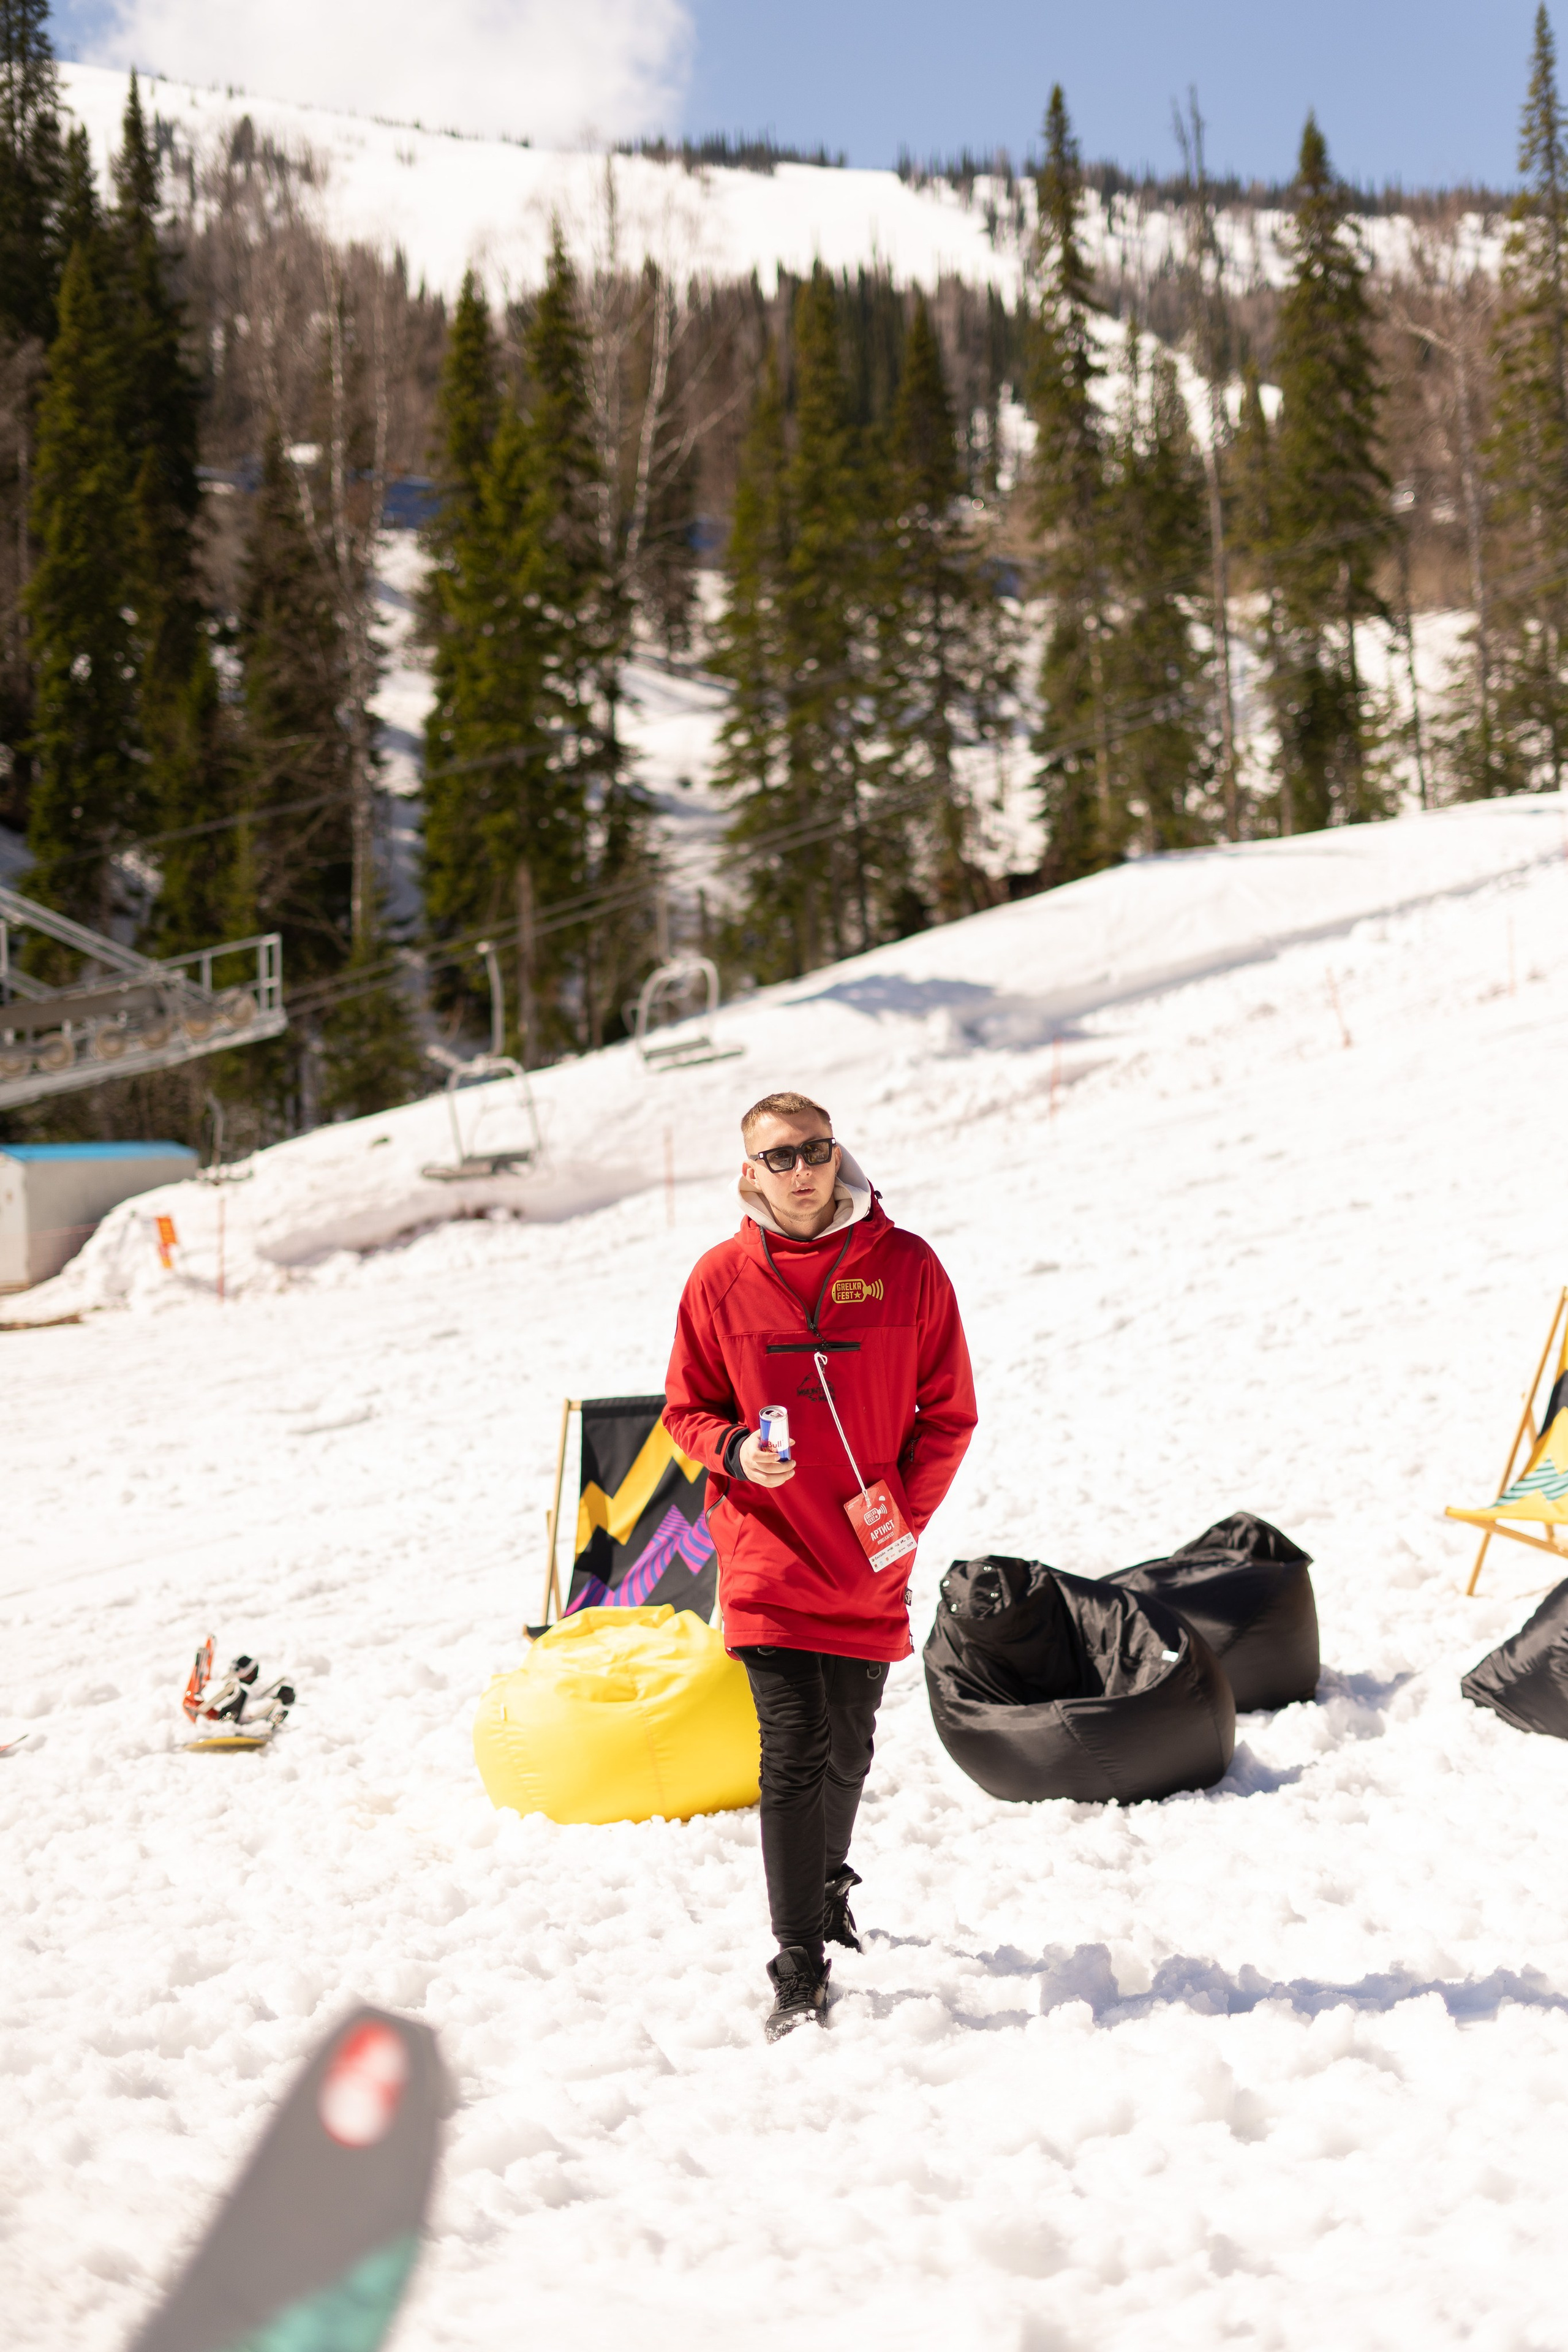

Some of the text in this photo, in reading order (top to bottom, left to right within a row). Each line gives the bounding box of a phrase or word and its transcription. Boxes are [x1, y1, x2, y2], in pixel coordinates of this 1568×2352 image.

[837, 1282, 862, 1291] GRELKA
[837, 1291, 854, 1300] FEST
[797, 1387, 835, 1396] MOUNTN
[870, 1519, 895, 1541] АРТИСТ
